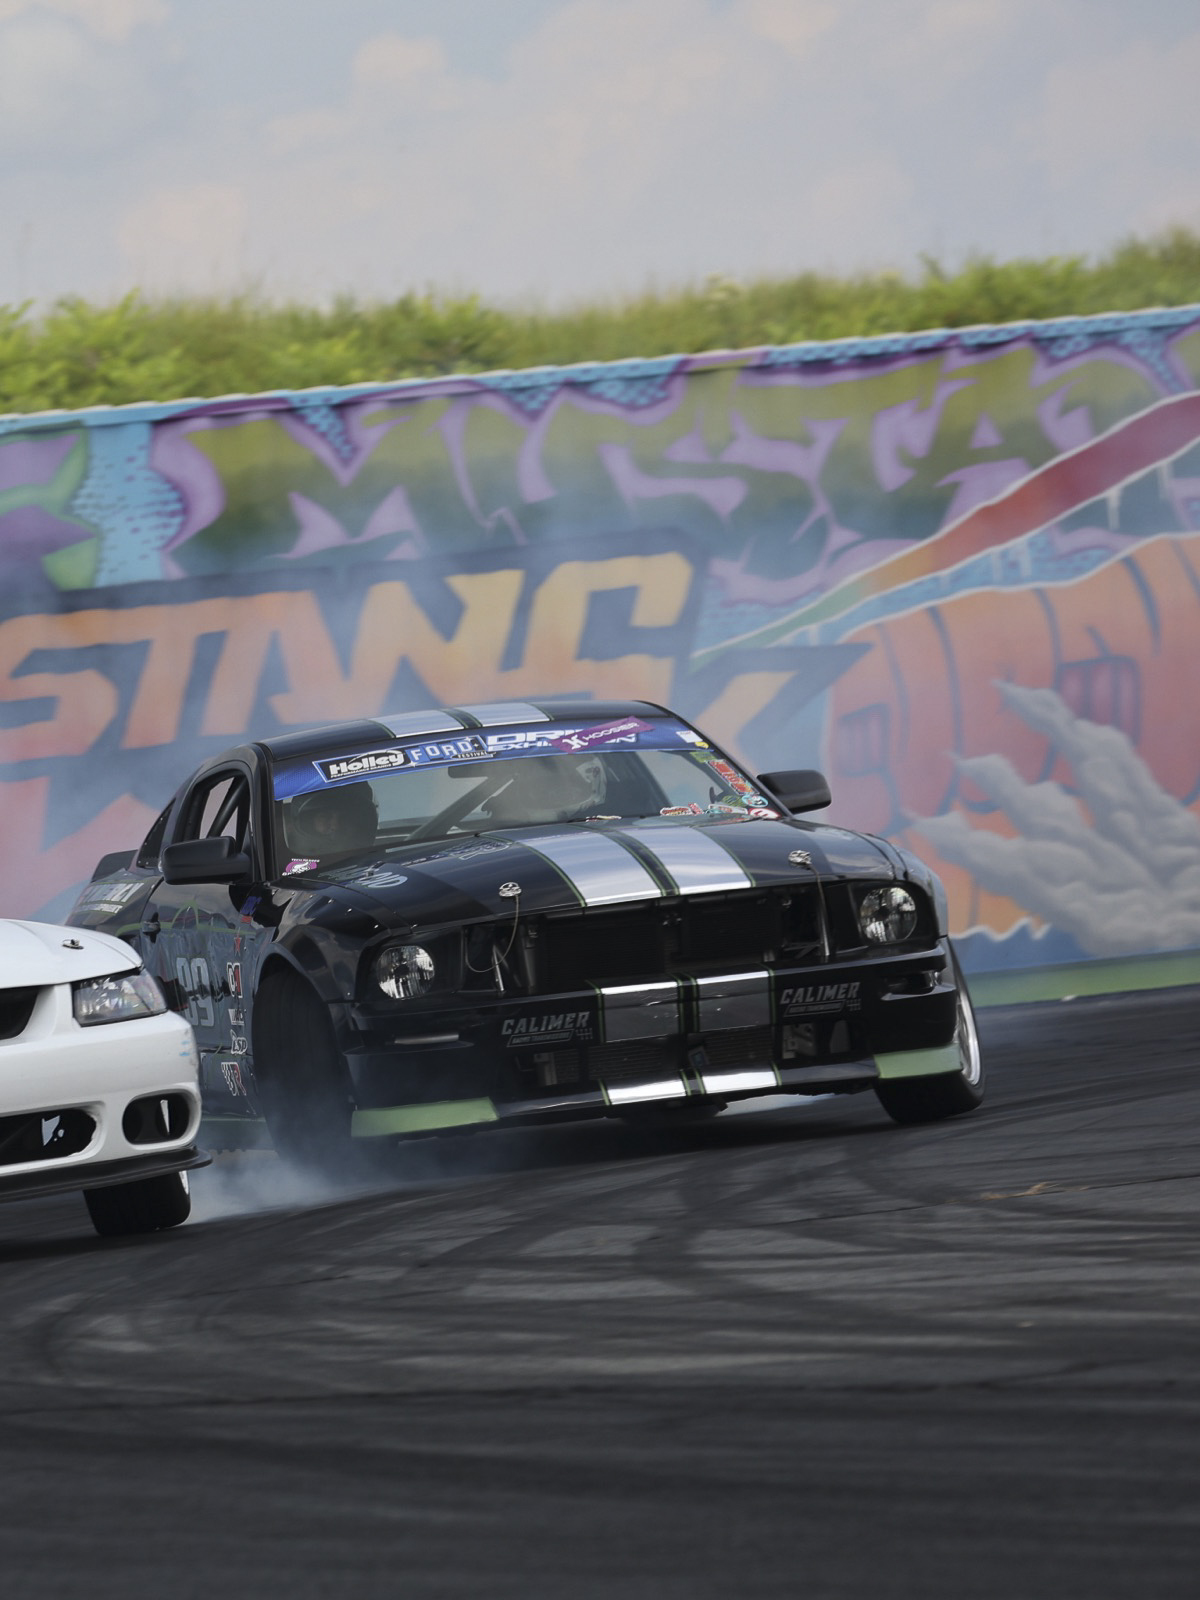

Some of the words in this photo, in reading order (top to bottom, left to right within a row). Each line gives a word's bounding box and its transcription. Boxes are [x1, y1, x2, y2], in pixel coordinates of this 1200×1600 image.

[582, 721, 640, 741] HOOSIER
[329, 749, 406, 775] Holley
[410, 740, 473, 761] FORD
[487, 729, 584, 746] DRI
[457, 750, 488, 759] FESTIVAL
[780, 982, 861, 1005] CALIMER
[501, 1011, 591, 1035] CALIMER
